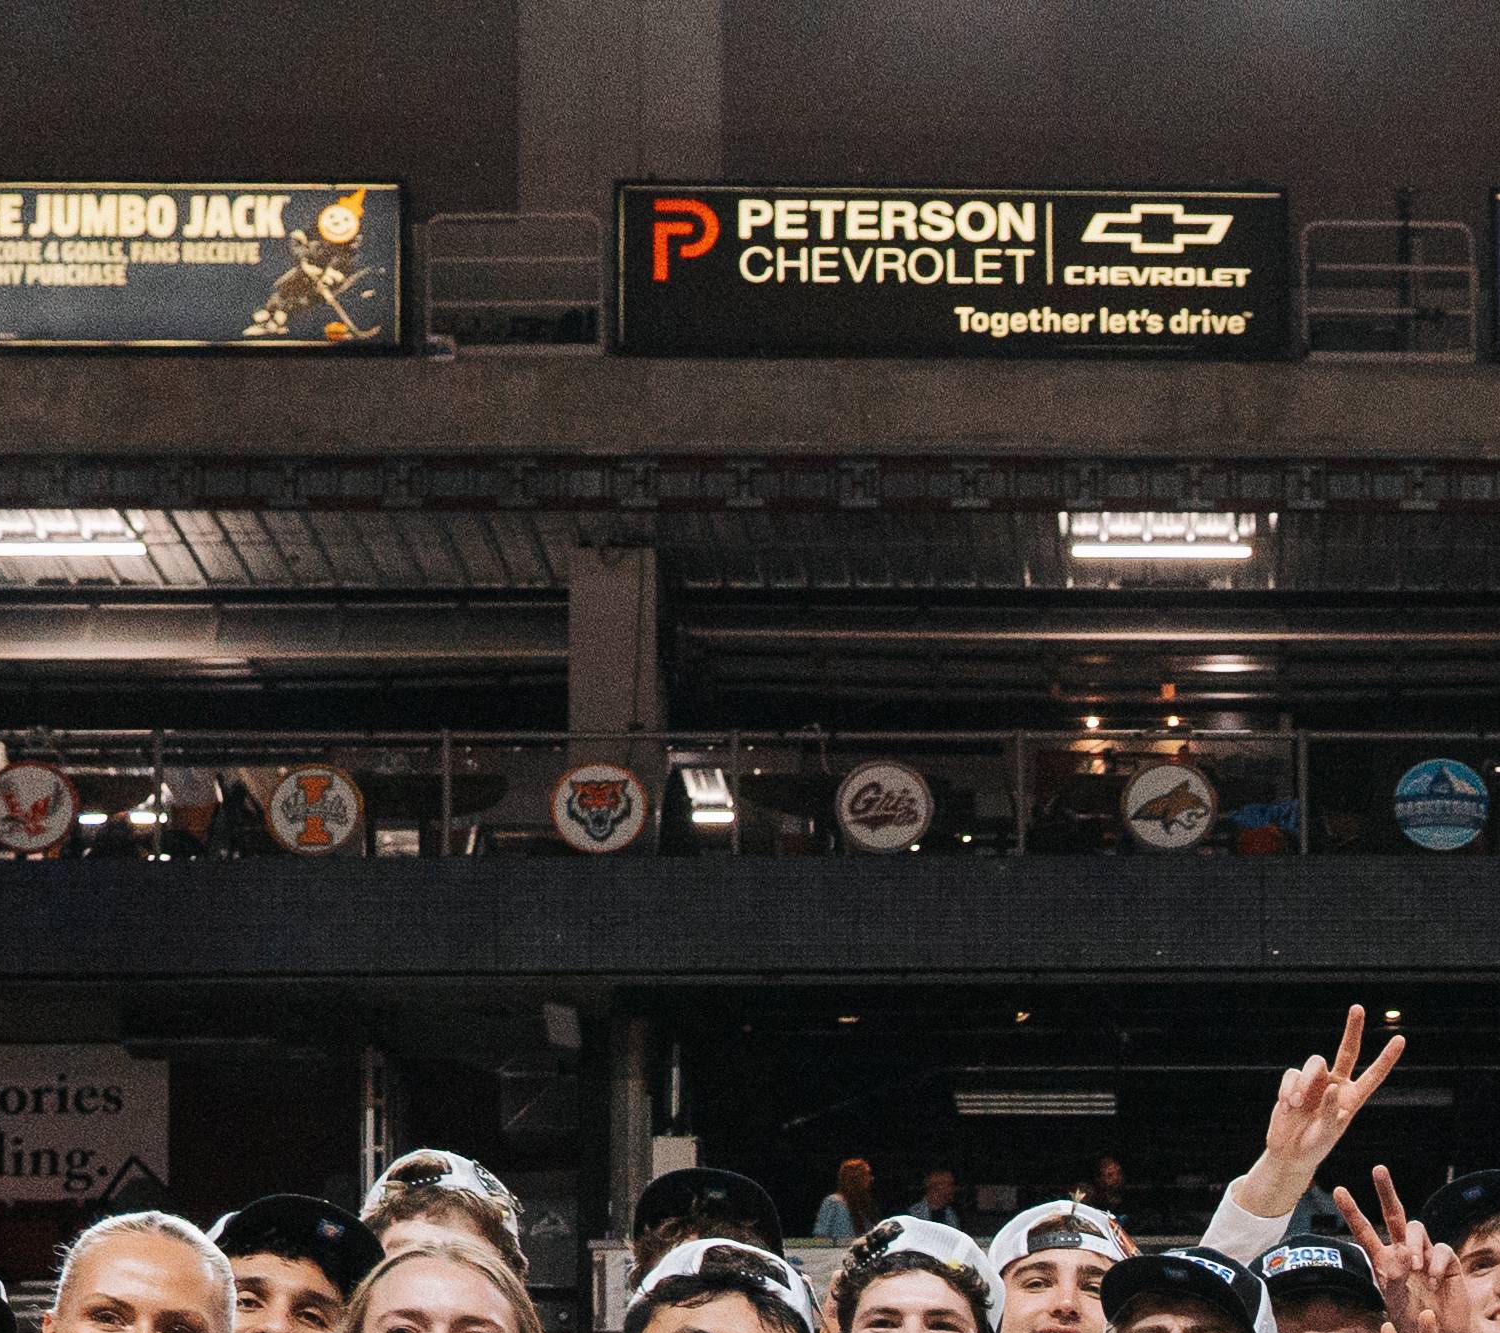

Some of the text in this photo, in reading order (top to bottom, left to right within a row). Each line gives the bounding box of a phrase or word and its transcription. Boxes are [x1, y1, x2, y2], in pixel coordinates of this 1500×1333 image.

[29, 194, 177, 238] JUMBO
[183, 194, 292, 238] JACK
[738, 201, 1036, 242] PETERSON
[738, 247, 1036, 285] CHEVROLET
[1064, 267, 1252, 288] CHEVROLET
[954, 306, 1246, 338] Together let's drive
[1287, 1248, 1341, 1265] 2026
